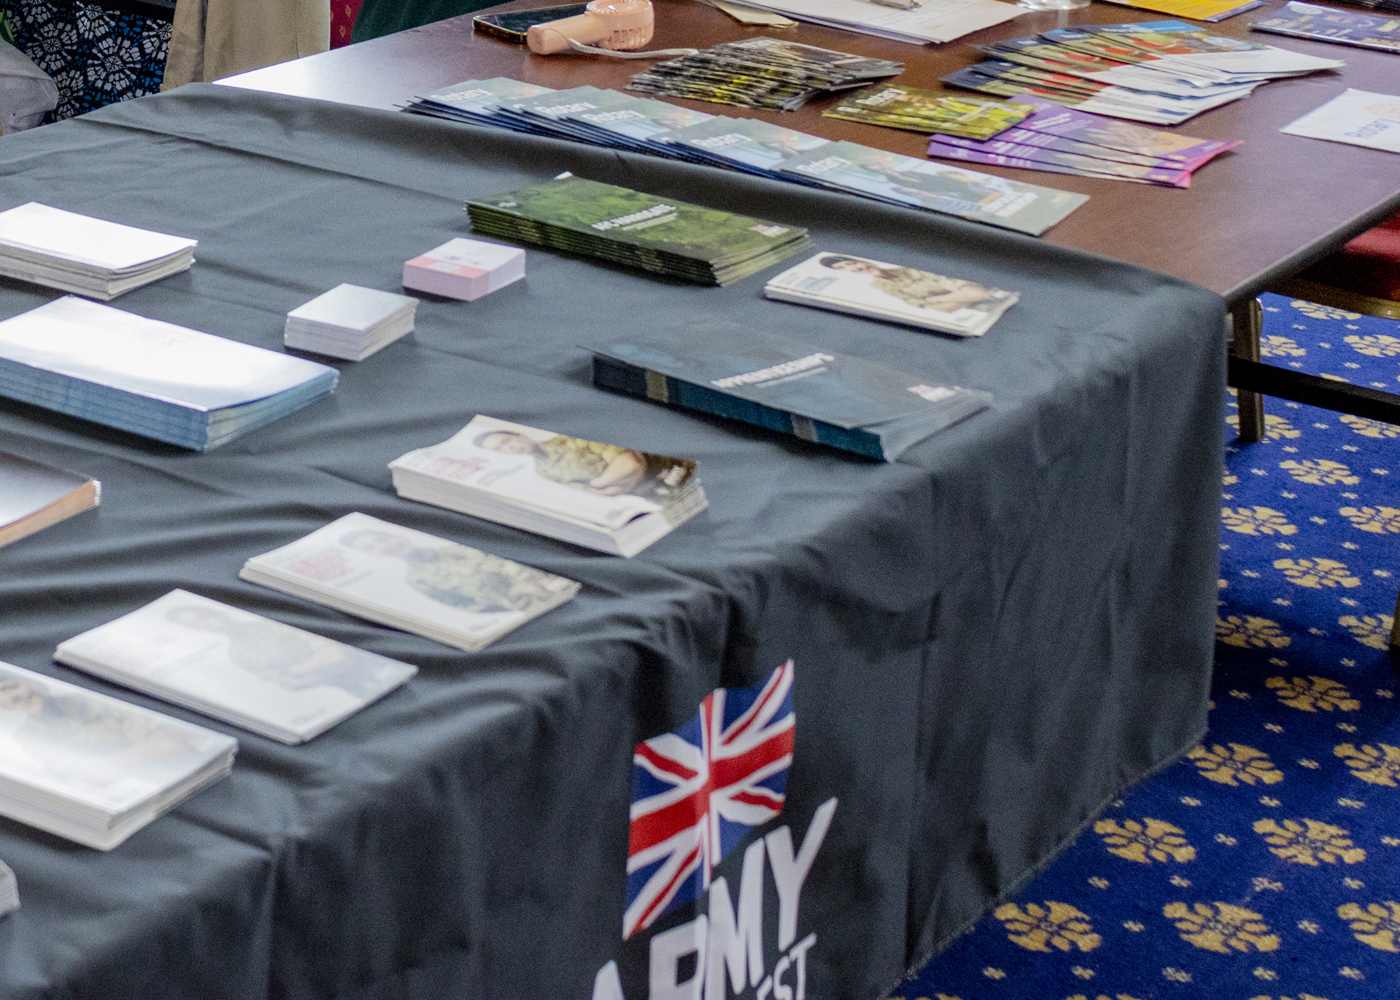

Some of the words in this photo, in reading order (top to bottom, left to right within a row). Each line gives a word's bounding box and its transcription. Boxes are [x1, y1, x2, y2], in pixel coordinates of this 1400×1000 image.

[581, 108, 646, 124] Rotary
[690, 132, 753, 149] Rotary
[795, 155, 853, 174] Rotary
